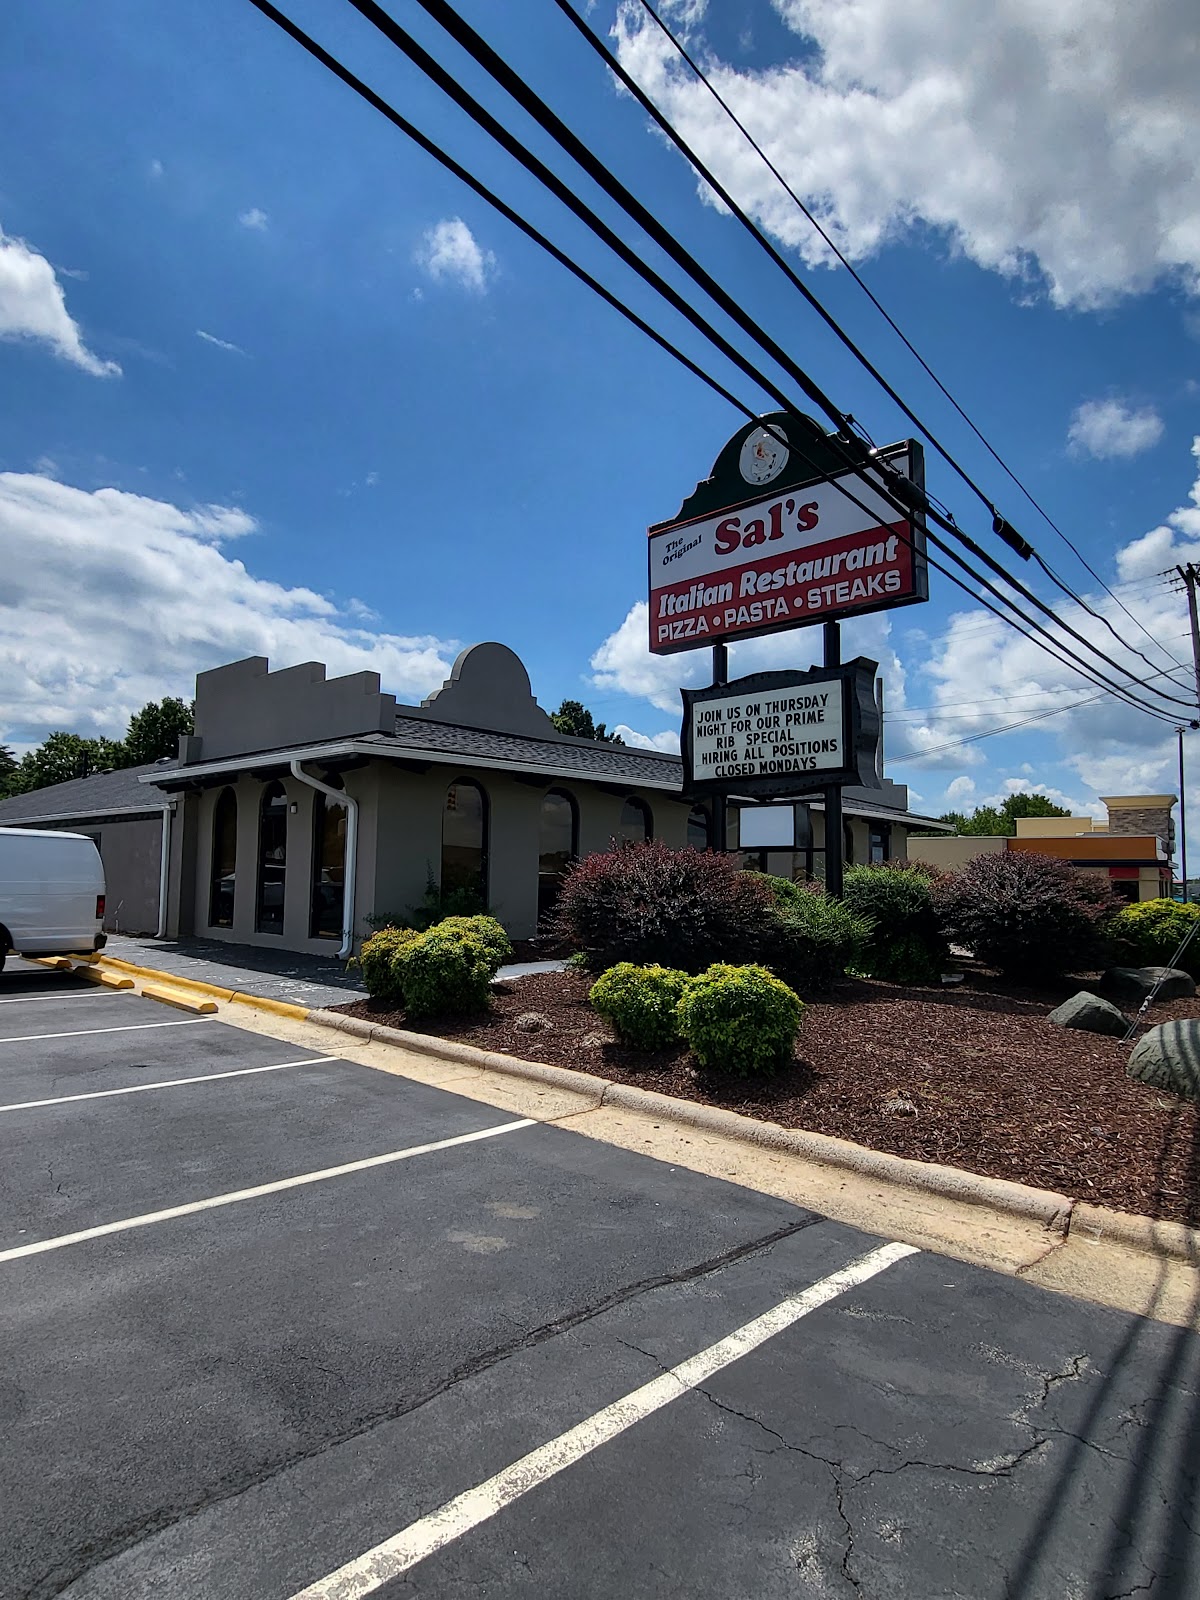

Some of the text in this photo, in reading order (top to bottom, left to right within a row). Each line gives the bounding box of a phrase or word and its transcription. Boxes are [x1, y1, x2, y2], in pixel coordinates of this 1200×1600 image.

[715, 499, 819, 555] Sal's
[662, 535, 702, 565] Original
[665, 536, 684, 552] The
[658, 535, 899, 617] Italian Restaurant
[658, 570, 900, 642] PIZZA PASTA STEAKS
[698, 694, 828, 723] JOIN US ON THURSDAY
[697, 710, 824, 737] NIGHT FOR OUR PRIME
[702, 739, 837, 764] HIRING ALL POSITIONS
[716, 729, 794, 749] RIB SPECIAL
[715, 757, 816, 777] CLOSED MONDAYS
